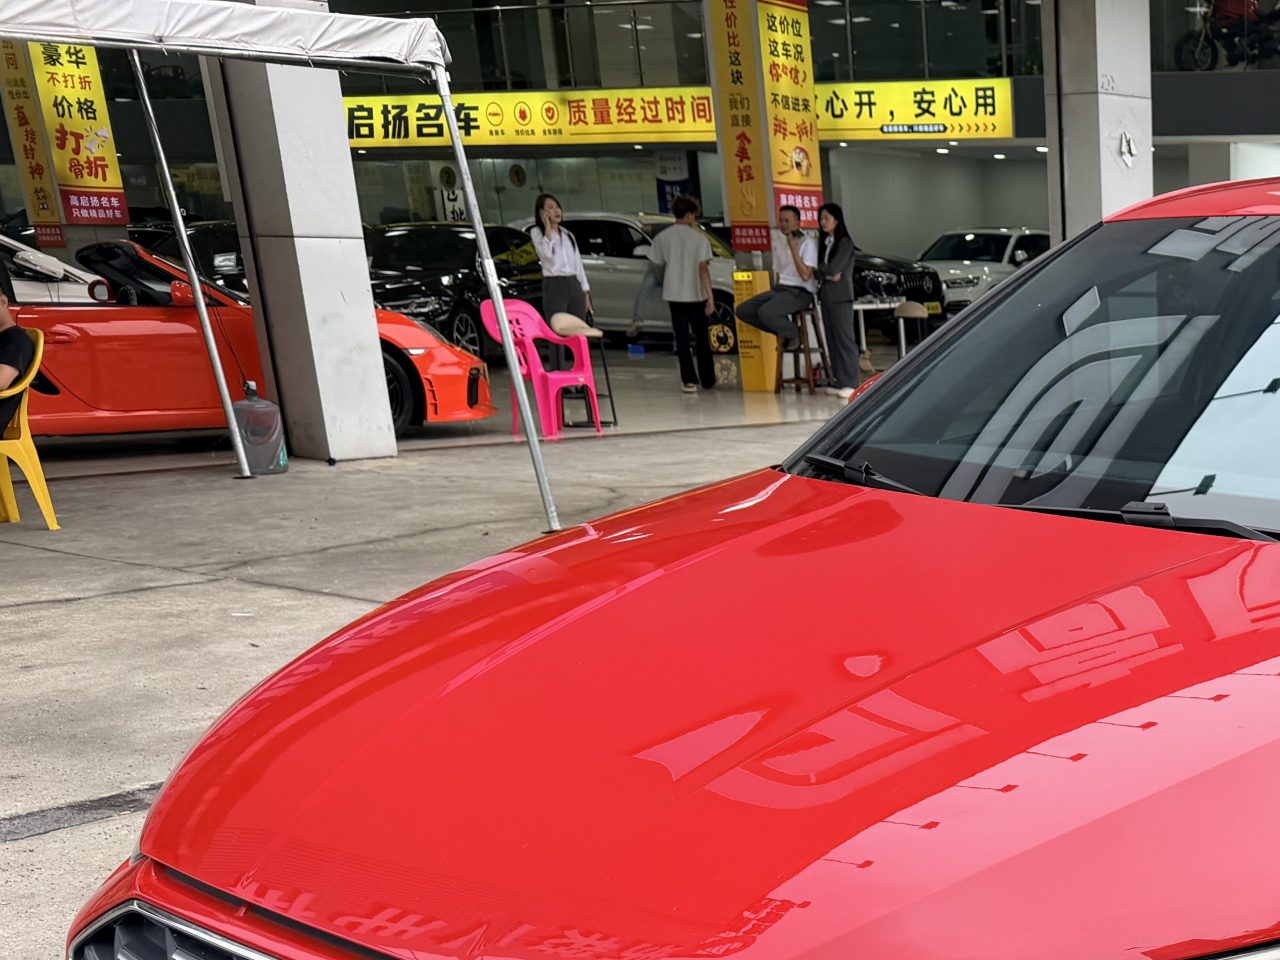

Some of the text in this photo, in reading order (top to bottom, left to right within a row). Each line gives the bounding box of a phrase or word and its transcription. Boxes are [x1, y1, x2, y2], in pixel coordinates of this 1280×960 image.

[766, 12, 802, 37] 这价位
[40, 43, 87, 69] 豪华
[768, 38, 804, 62] 这车况
[46, 71, 92, 91] 不打折
[52, 95, 98, 122] 价格
[567, 96, 713, 127] 质量经过时间
[771, 92, 811, 113] 不信进来
[814, 87, 996, 122] 心开，安心用
[347, 103, 481, 140] 启扬名车
[55, 122, 85, 156] 打
[68, 156, 109, 182] 骨折
[69, 195, 120, 208] 高启扬名车
